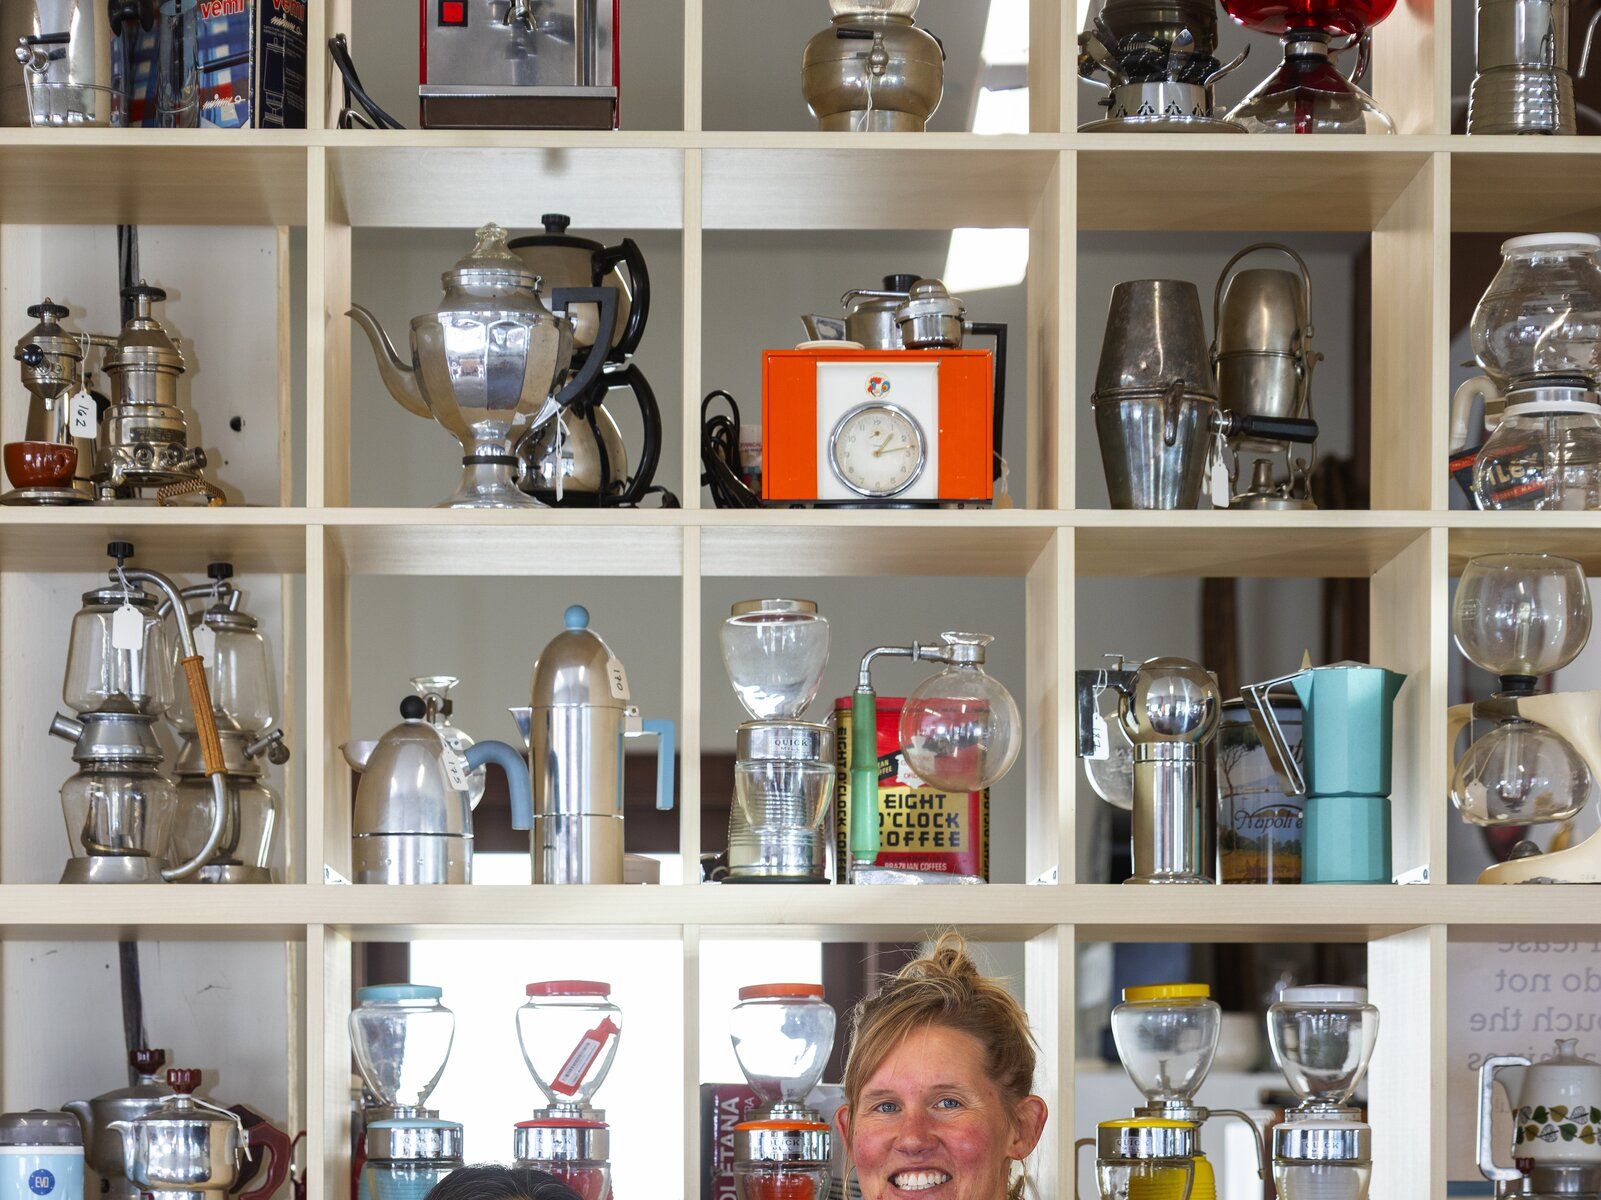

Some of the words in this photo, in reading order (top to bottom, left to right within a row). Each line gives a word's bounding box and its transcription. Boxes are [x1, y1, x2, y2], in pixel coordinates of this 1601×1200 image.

[76, 405, 89, 427] 162
[774, 739, 808, 748] QUICK
[837, 727, 847, 768] EIGHT
[837, 772, 847, 827] O'CLOCK
[884, 794, 946, 810] EIGHT
[920, 862, 947, 871] COFFEES
